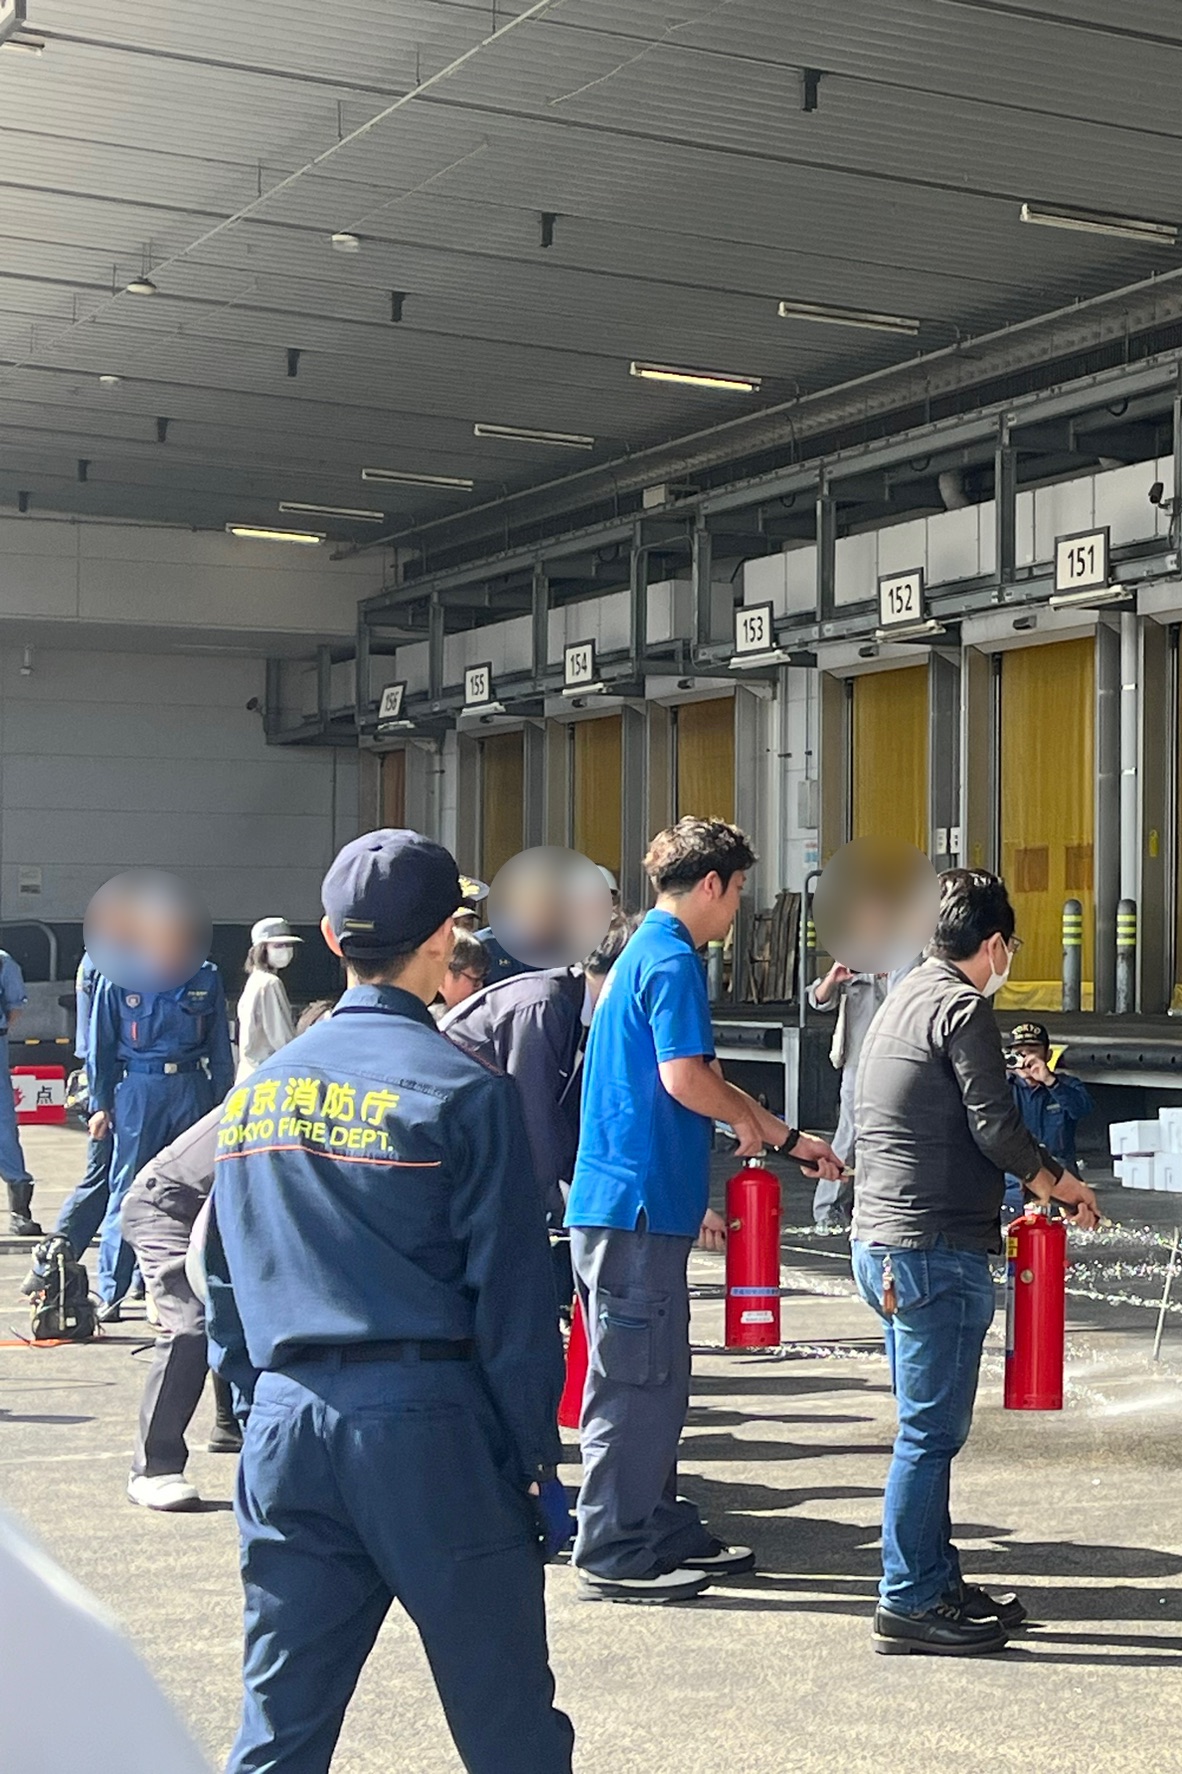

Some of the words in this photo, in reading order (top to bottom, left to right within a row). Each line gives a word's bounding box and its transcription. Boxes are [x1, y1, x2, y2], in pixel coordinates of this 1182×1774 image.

[1067, 544, 1094, 578] 151
[888, 584, 912, 614] 152
[743, 616, 764, 643] 153
[570, 652, 587, 676] 154
[470, 673, 485, 696] 155
[220, 1077, 400, 1126] 東京消防庁
[217, 1118, 274, 1148] TOKYO
[278, 1116, 326, 1144] FIRE
[330, 1126, 394, 1151] DEPT.
